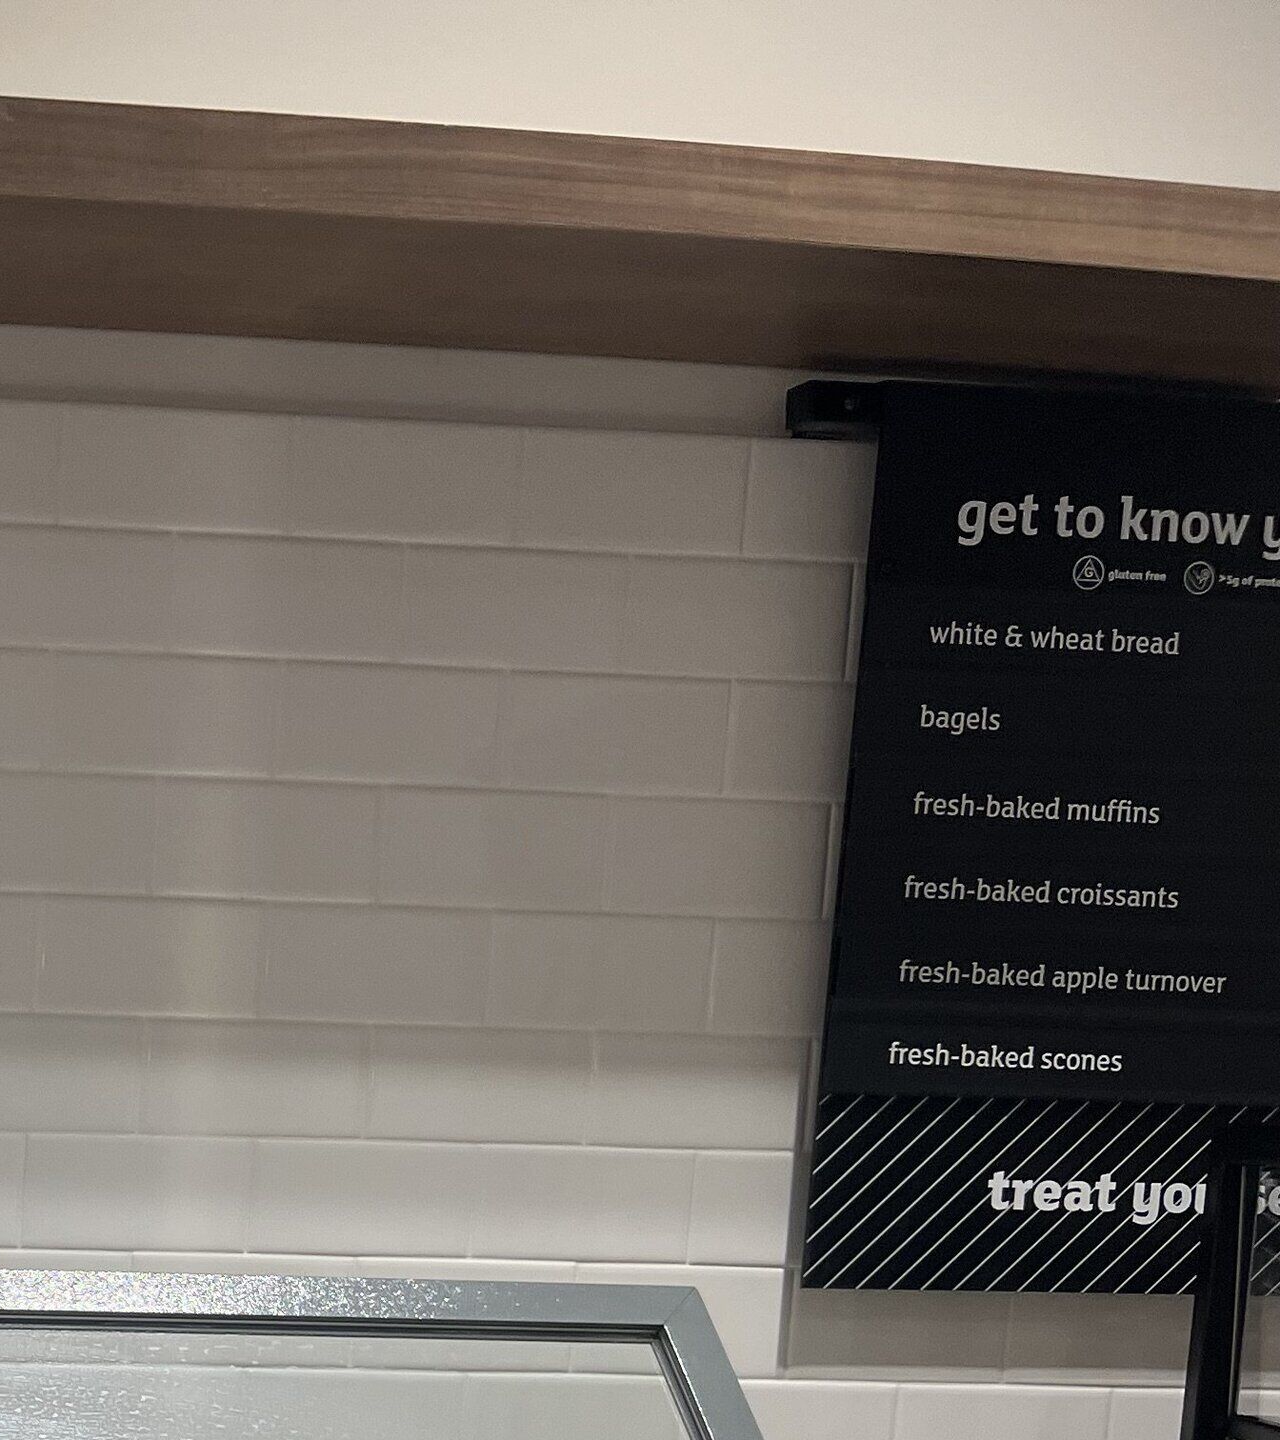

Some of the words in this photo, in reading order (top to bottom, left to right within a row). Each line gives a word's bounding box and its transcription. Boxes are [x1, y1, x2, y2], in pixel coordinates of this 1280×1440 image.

[958, 494, 1039, 546] get
[1054, 496, 1104, 538] to
[1121, 496, 1250, 545] know
[930, 621, 997, 646] white
[1005, 625, 1022, 647] &
[1031, 626, 1104, 651] wheat
[1112, 629, 1179, 654] bread
[921, 704, 1000, 735] bagels
[914, 791, 1060, 819] fresh-baked
[1068, 799, 1159, 823] muffins
[905, 875, 1050, 903] fresh-baked
[1058, 883, 1178, 908] croissants
[899, 959, 1045, 986] fresh-baked
[1052, 967, 1118, 993] apple
[1126, 969, 1226, 993] turnover
[889, 1042, 1034, 1068] fresh-baked
[1041, 1053, 1122, 1071] scones
[988, 1171, 1117, 1212] treat
